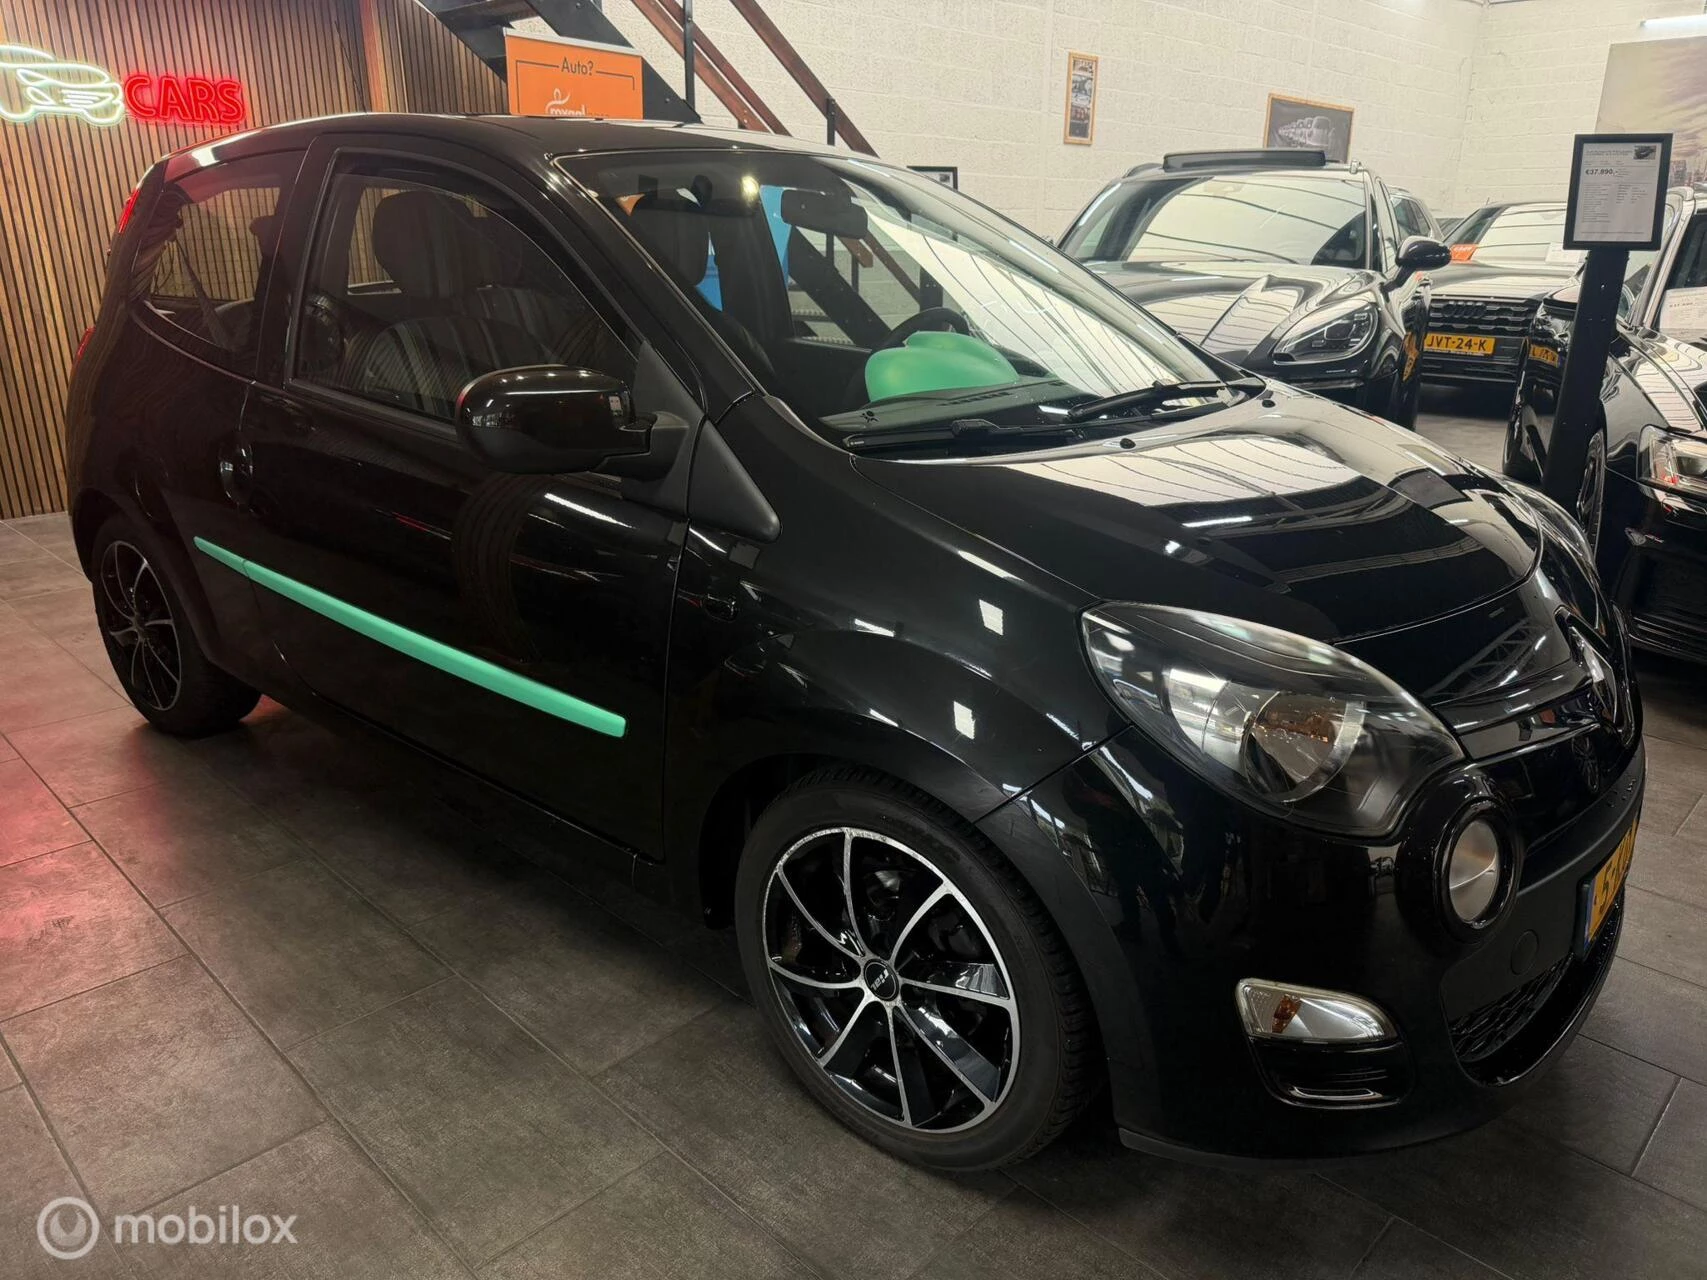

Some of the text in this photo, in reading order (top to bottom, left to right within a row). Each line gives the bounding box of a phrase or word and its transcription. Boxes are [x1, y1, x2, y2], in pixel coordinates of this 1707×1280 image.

[561, 56, 595, 76] Auto?
[124, 75, 246, 123] CARS
[1426, 335, 1487, 352] JVT-24-K
